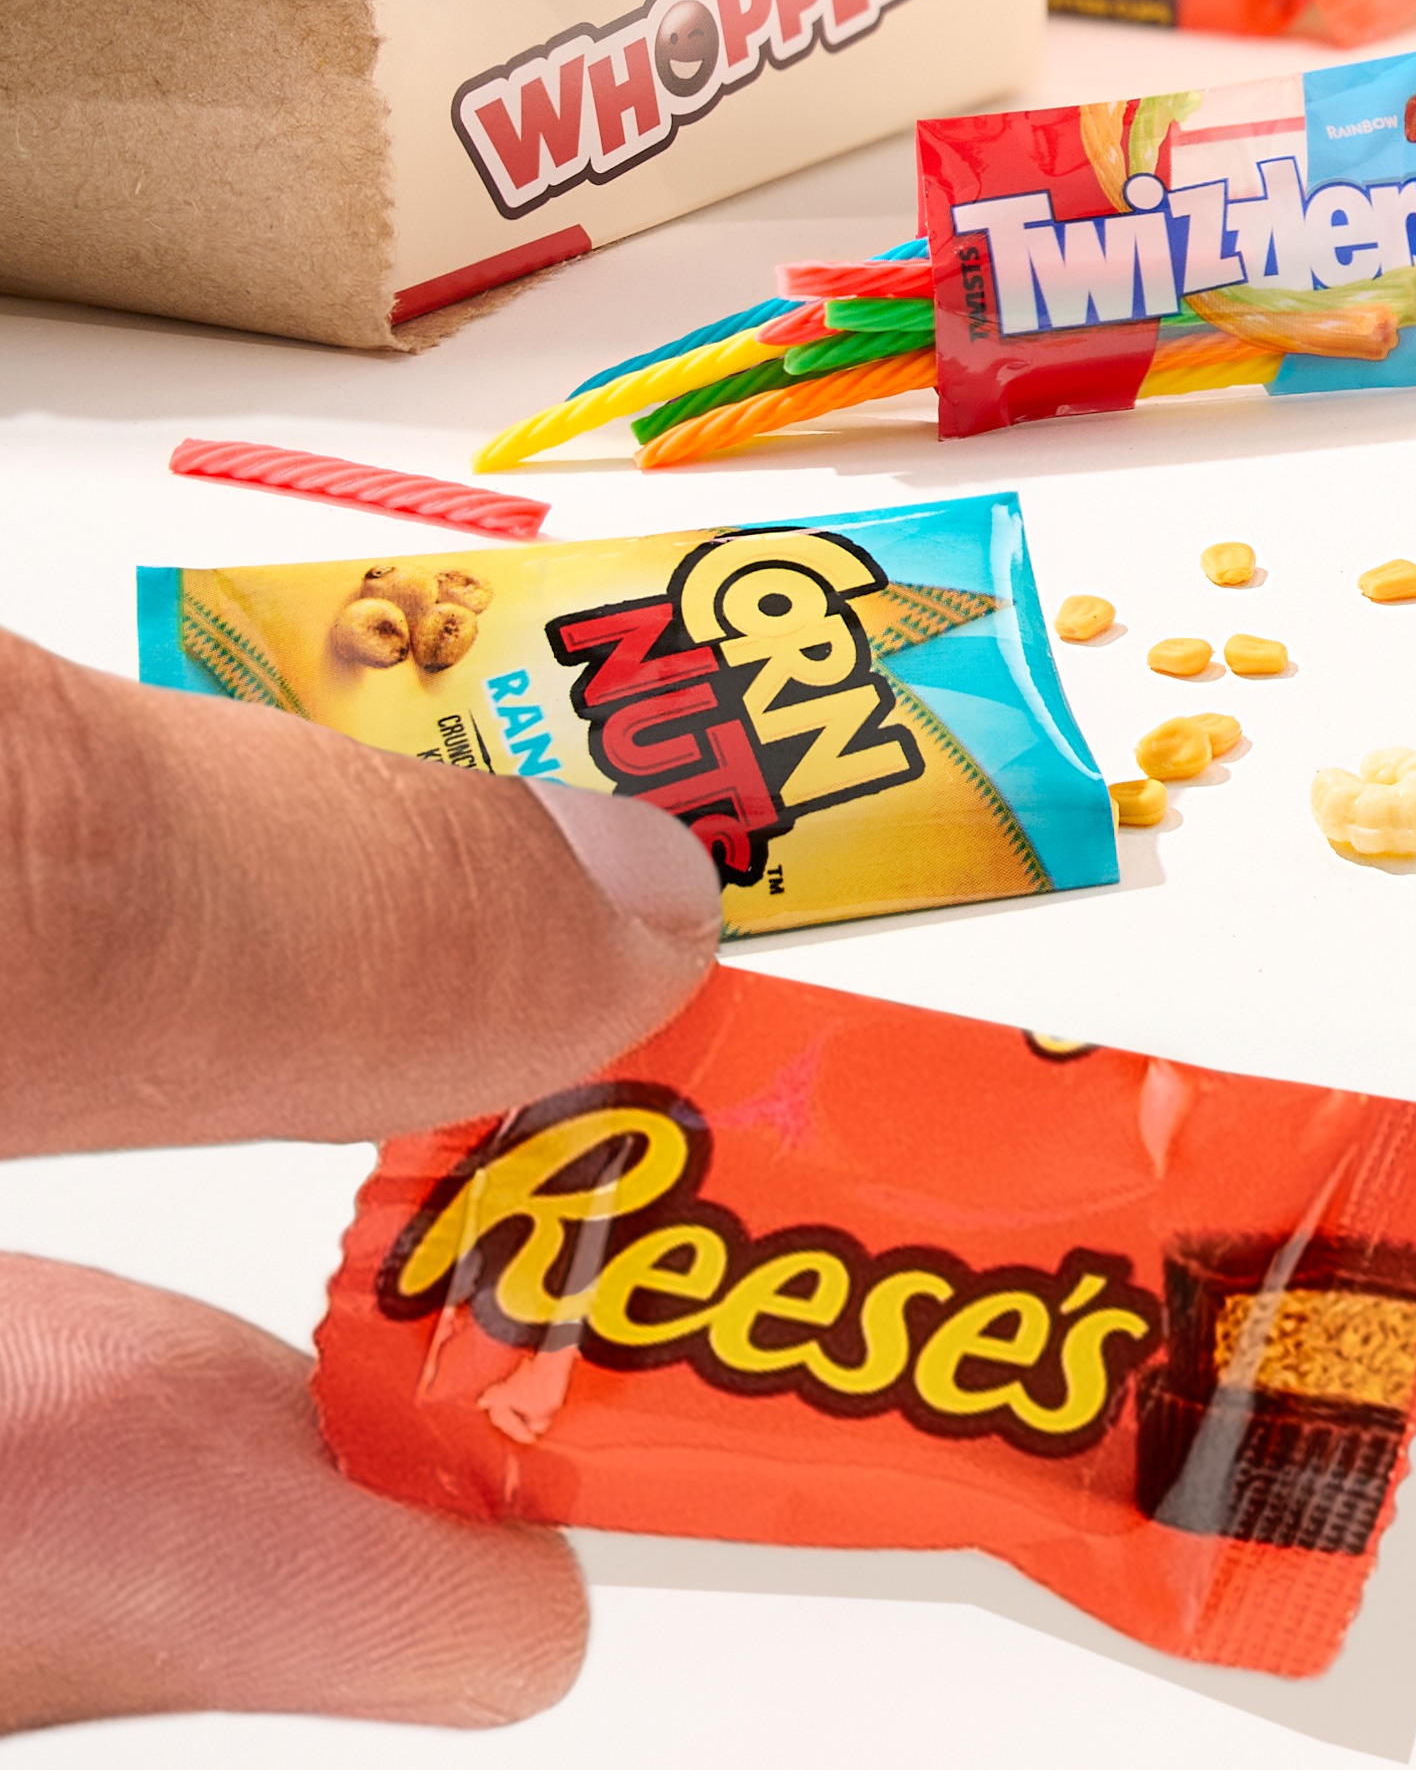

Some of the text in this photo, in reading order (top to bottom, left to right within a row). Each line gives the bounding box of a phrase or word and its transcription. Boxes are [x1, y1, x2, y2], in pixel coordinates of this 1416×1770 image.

[1326, 113, 1400, 141] RAINBOW
[486, 668, 566, 782] RAN
[680, 529, 911, 808] CORN
[396, 1105, 1148, 1436] Reese's
